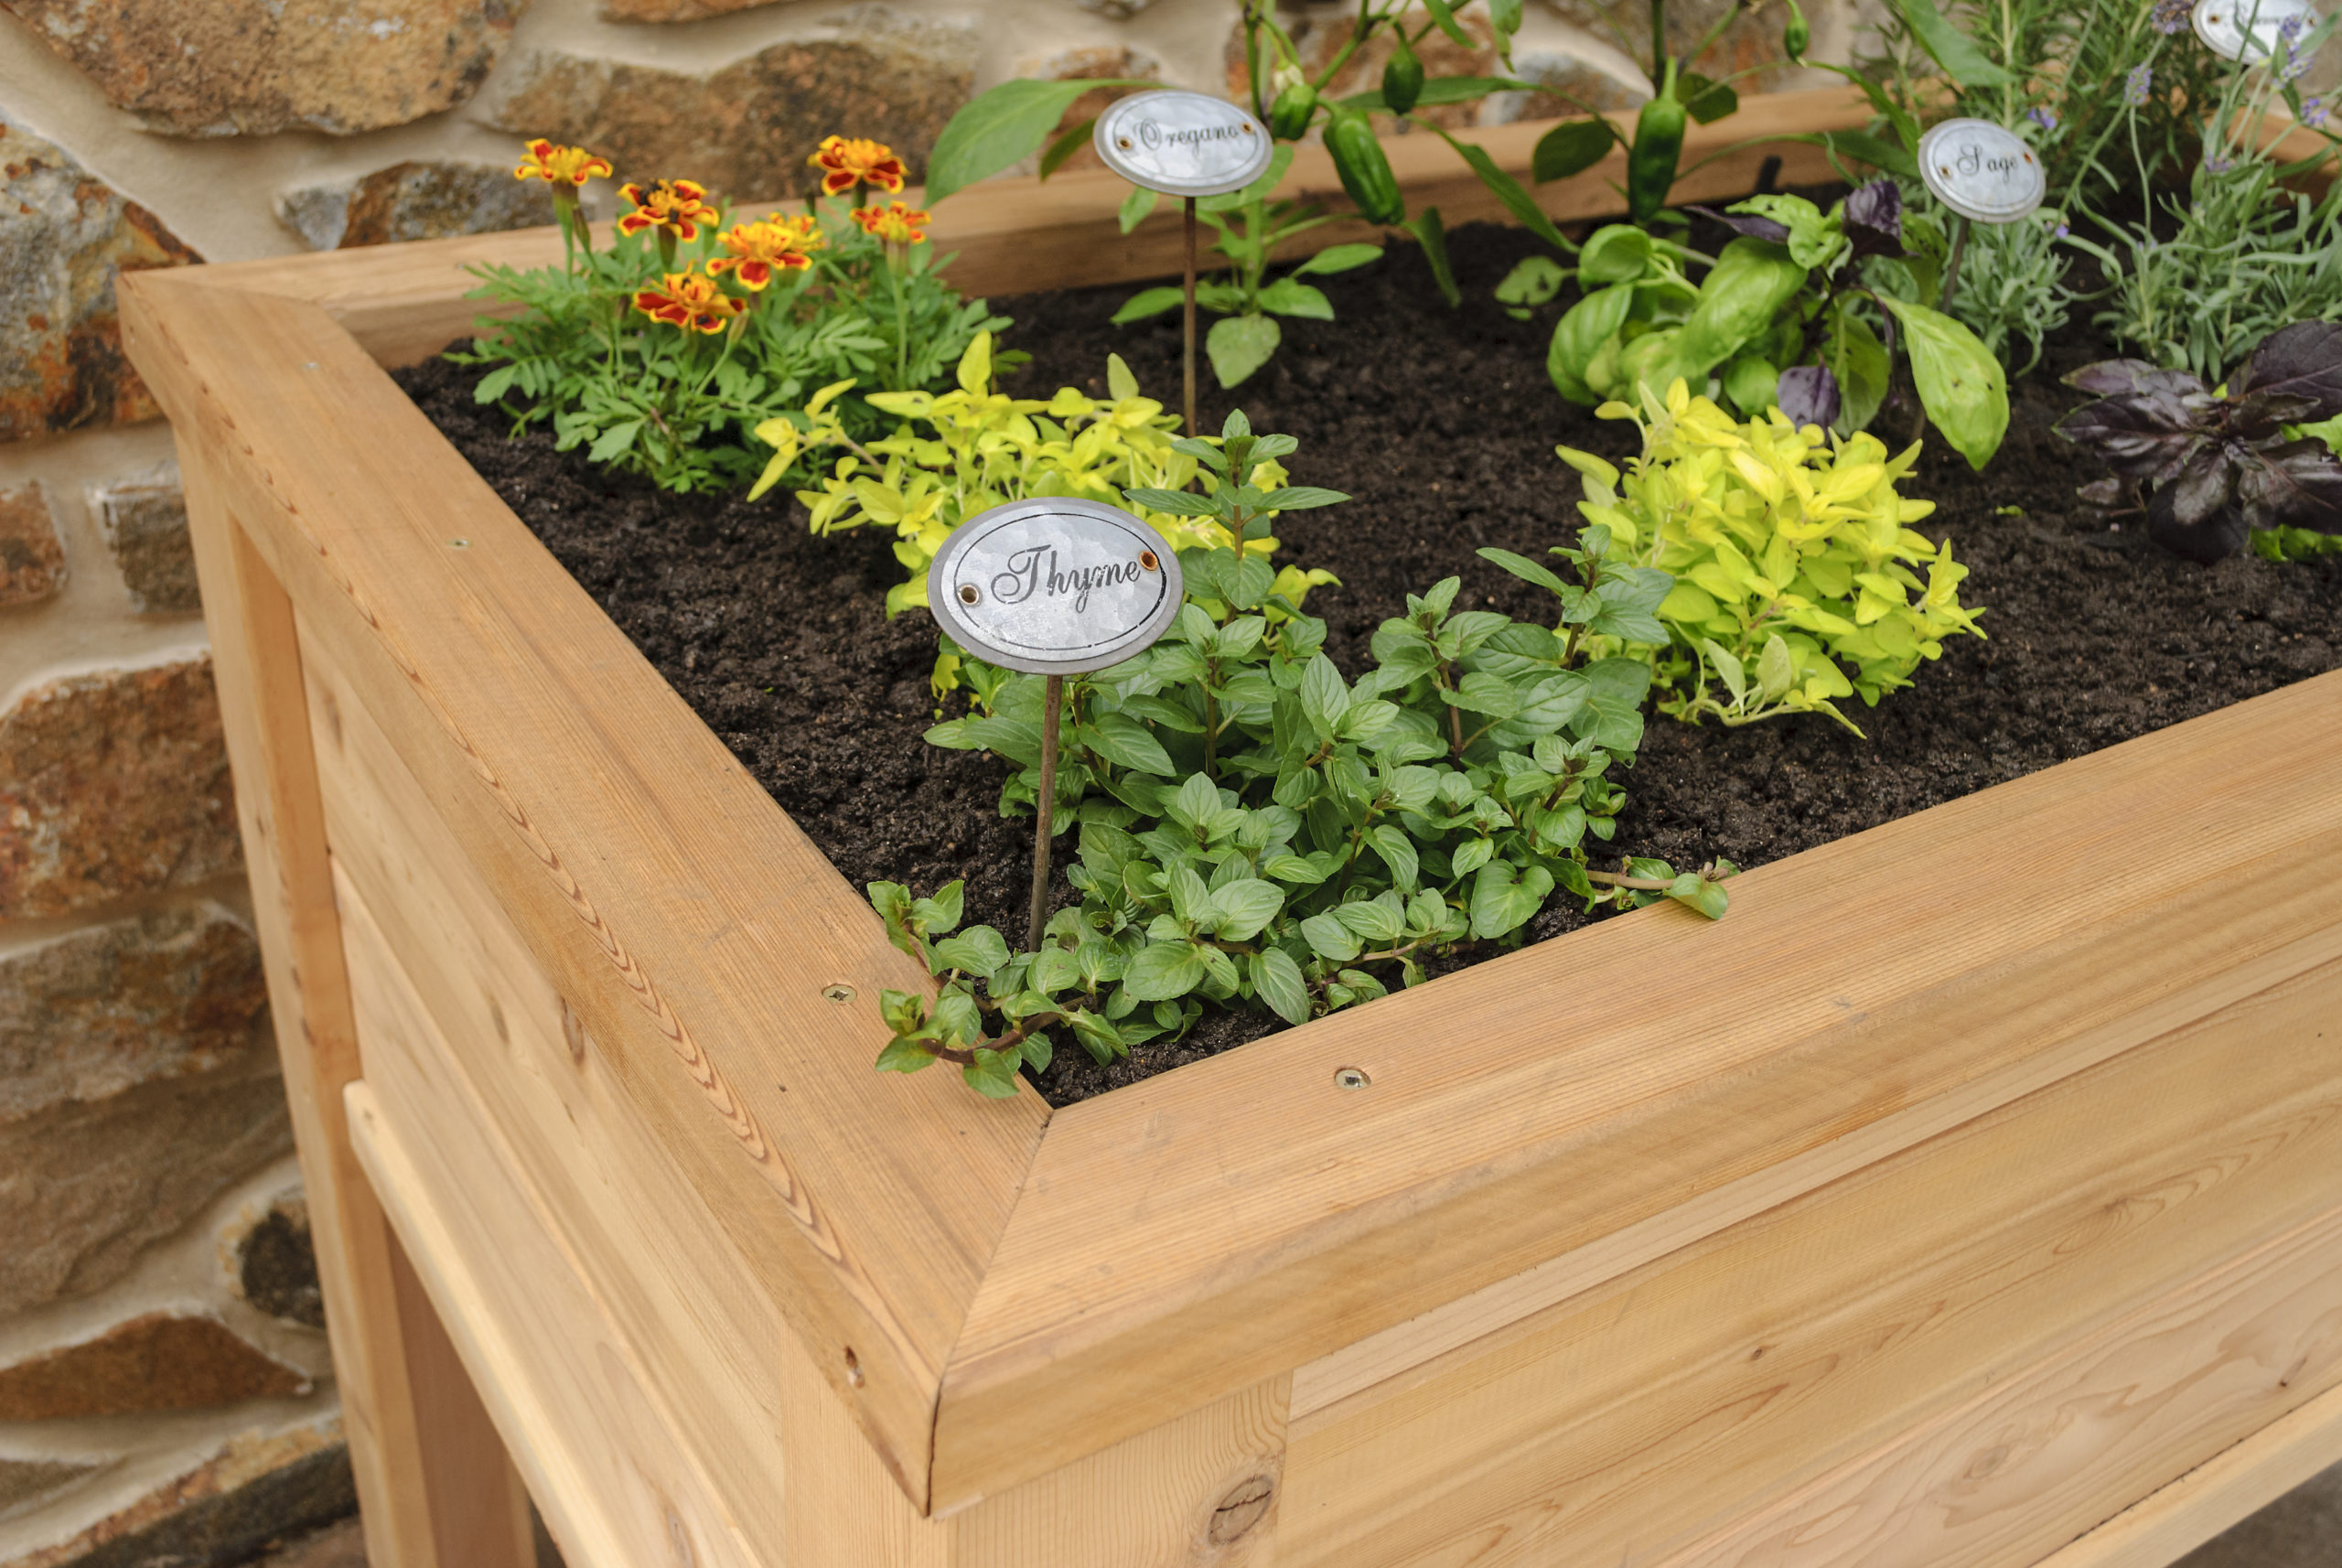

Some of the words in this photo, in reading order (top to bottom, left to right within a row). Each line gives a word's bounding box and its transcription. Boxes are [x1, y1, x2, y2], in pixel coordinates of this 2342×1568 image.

[1134, 118, 1238, 159] Oregano
[1957, 144, 2017, 183] Sage
[991, 544, 1140, 613] Thyme
